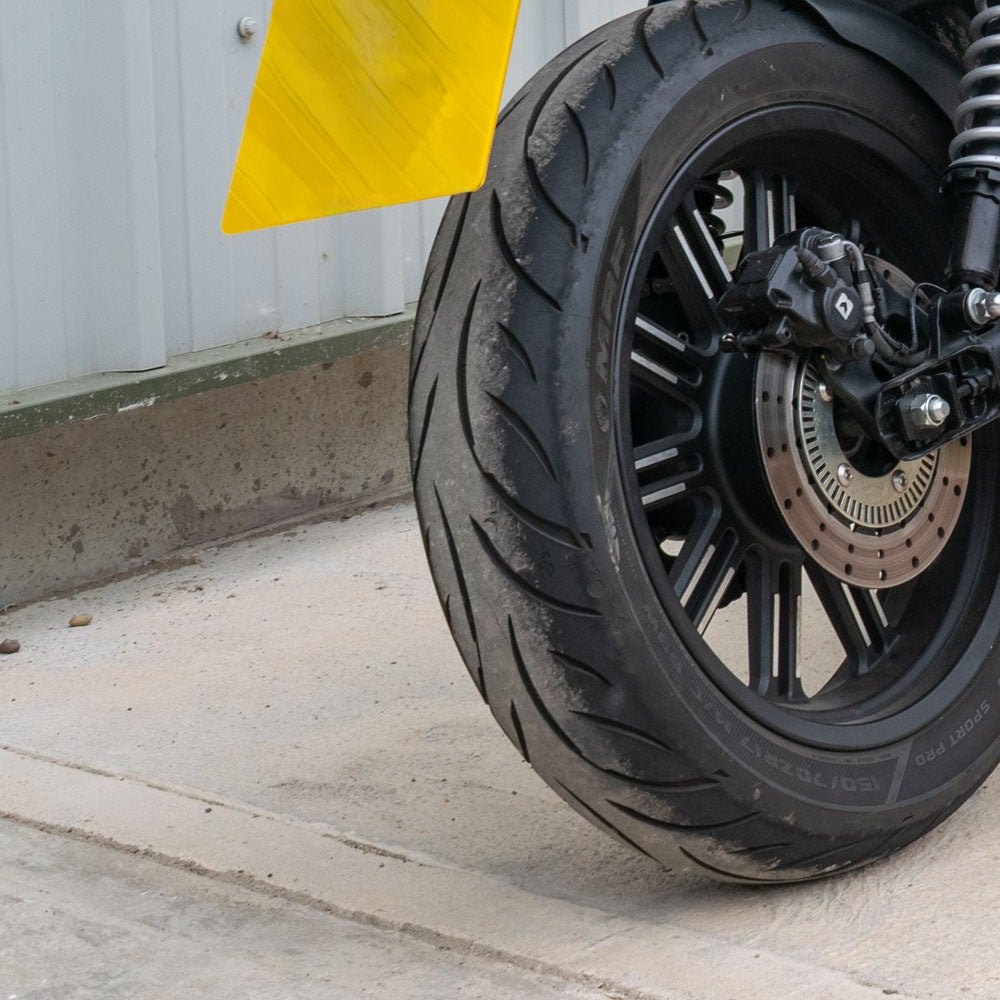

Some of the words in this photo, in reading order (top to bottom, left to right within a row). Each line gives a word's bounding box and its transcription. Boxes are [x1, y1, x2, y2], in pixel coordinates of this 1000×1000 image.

[596, 226, 626, 385] MRF
[949, 699, 991, 747] SPORT
[914, 742, 947, 767] PRO
